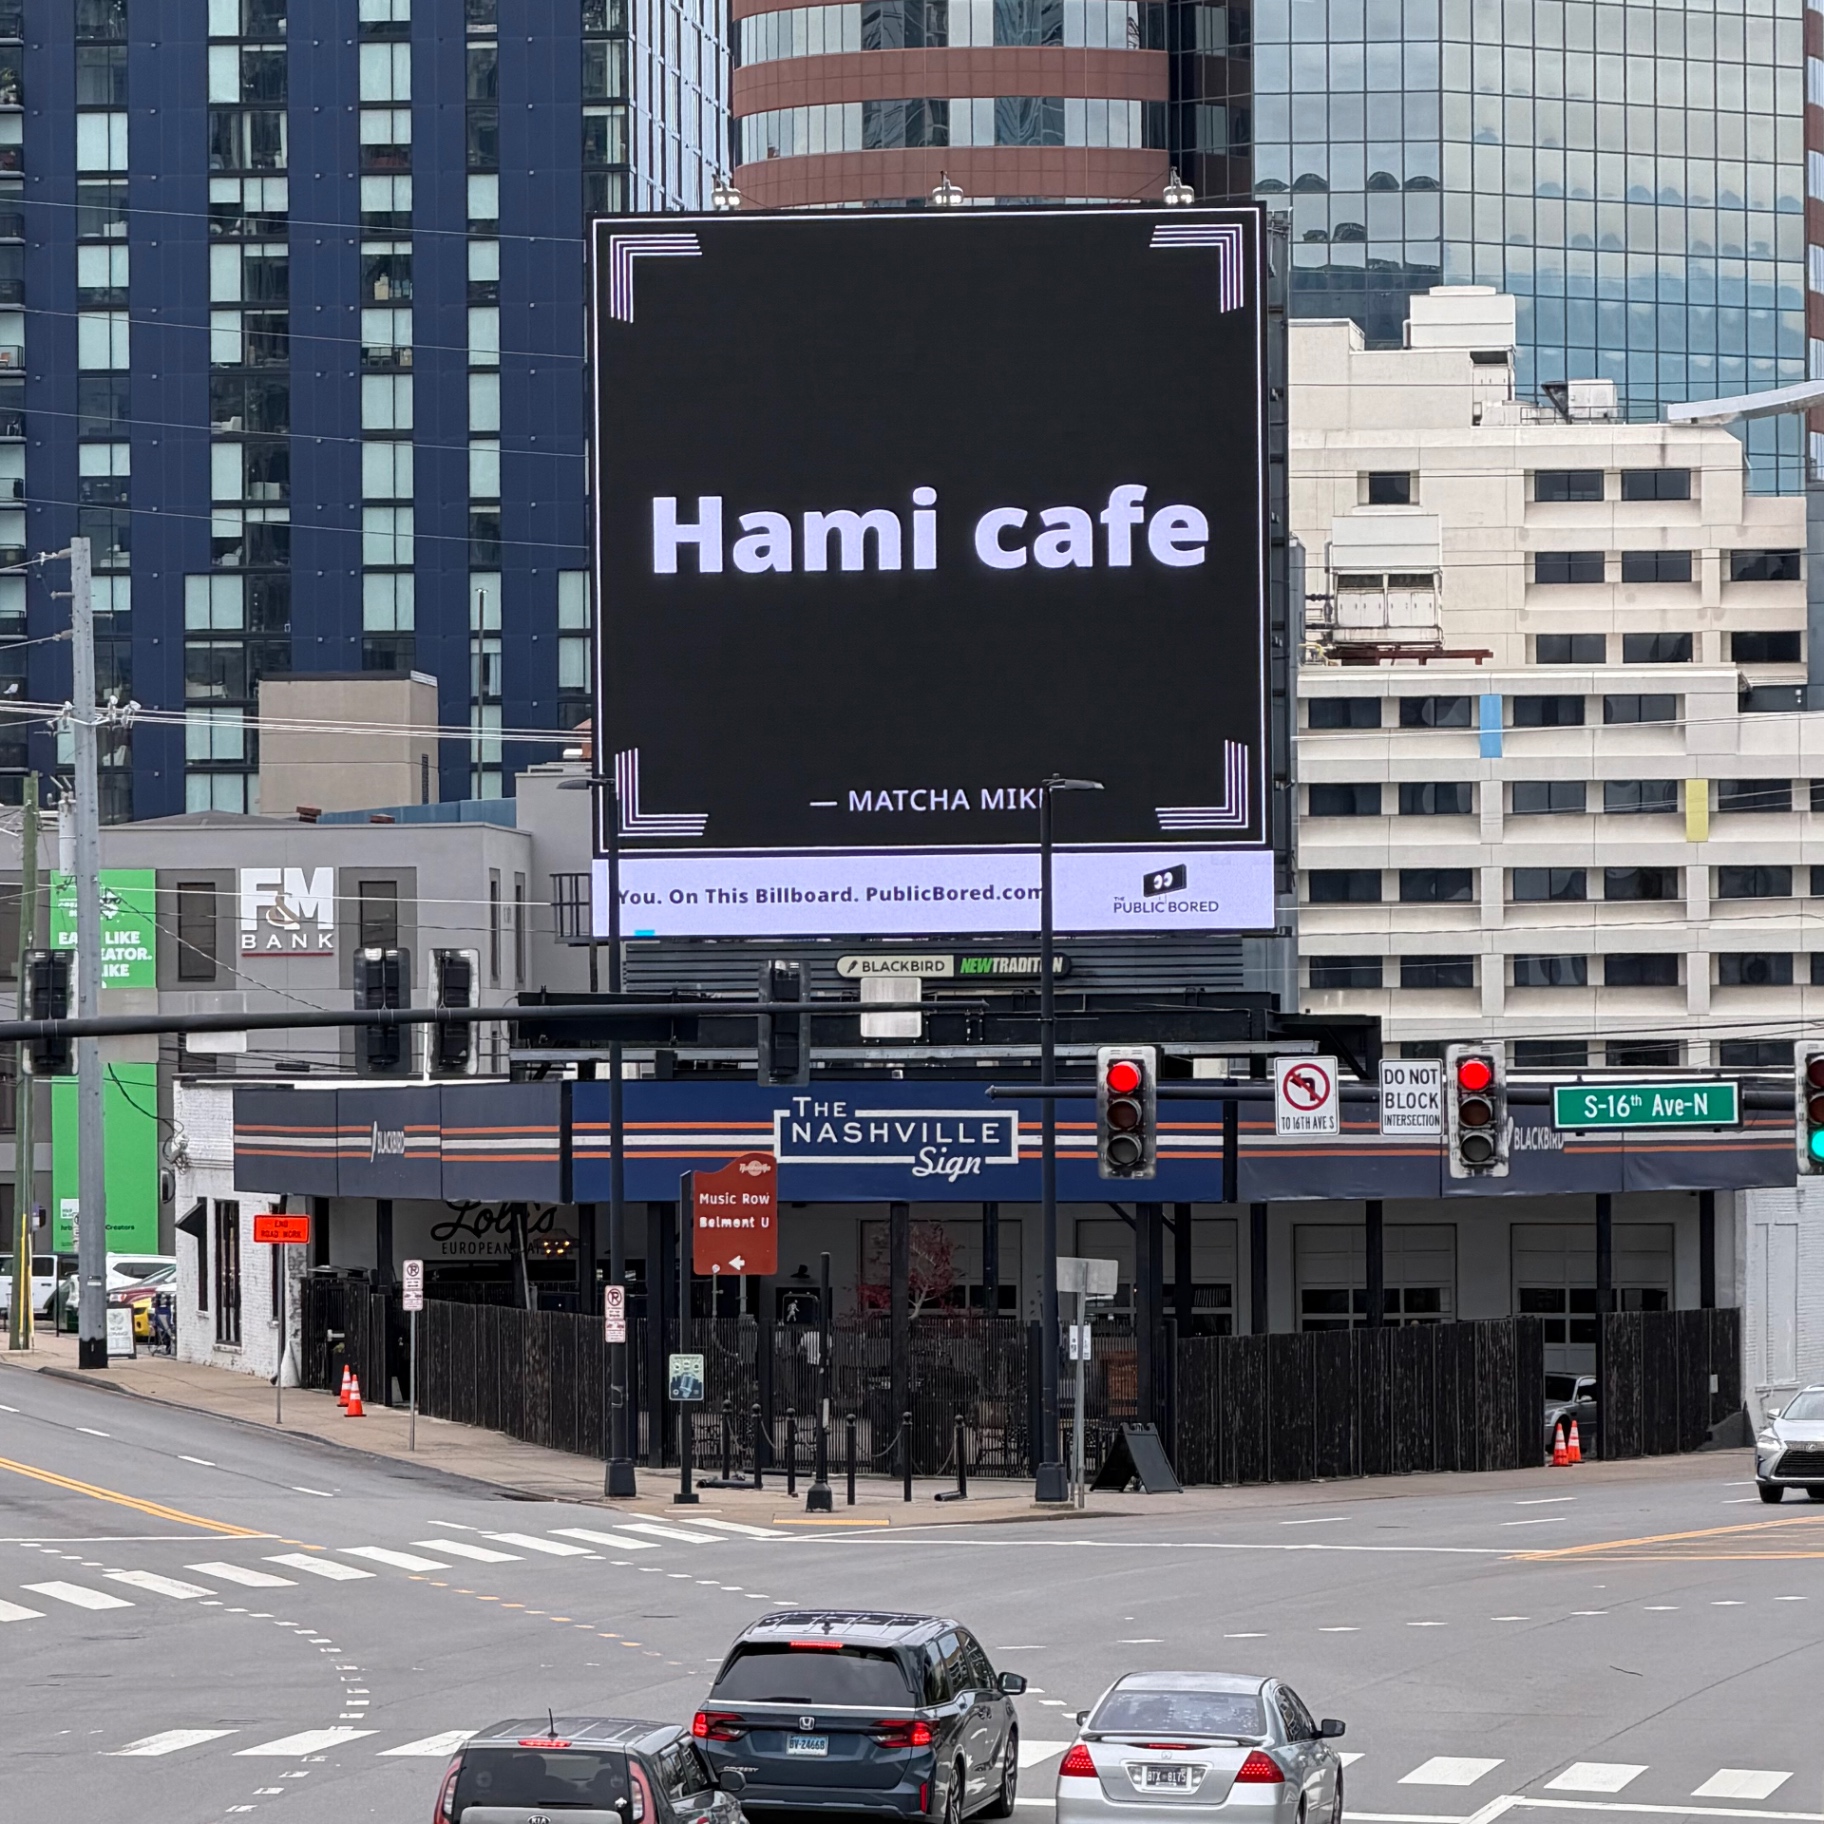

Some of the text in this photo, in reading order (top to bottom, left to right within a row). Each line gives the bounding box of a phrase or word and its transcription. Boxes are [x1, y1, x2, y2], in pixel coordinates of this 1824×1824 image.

[653, 484, 1209, 574] Hami cafe
[849, 789, 970, 811] MATCHA
[241, 867, 334, 930] F&M
[619, 889, 662, 904] You.
[669, 889, 698, 904] On
[705, 888, 749, 903] This
[756, 887, 858, 903] Billboard.
[1113, 901, 1219, 913] PUBLIC BORED
[105, 931, 141, 944] LIKE
[242, 933, 334, 949] BANK
[101, 964, 130, 977] IKE
[862, 960, 945, 973] BLACKBIRD
[1384, 1068, 1439, 1085] DO NOT
[1385, 1092, 1439, 1109] BLOCK
[1584, 1093, 1709, 1118] S-16th Ave-N
[1281, 1115, 1335, 1130] TO 16TH AVE S
[1384, 1114, 1440, 1127] INTERSECTION
[792, 1122, 1000, 1144] NASHVILLE
[1514, 1126, 1565, 1150] BLACKBIRD
[912, 1147, 981, 1182] Sign
[699, 1192, 770, 1205] Music Row
[699, 1216, 770, 1228] Belmont U
